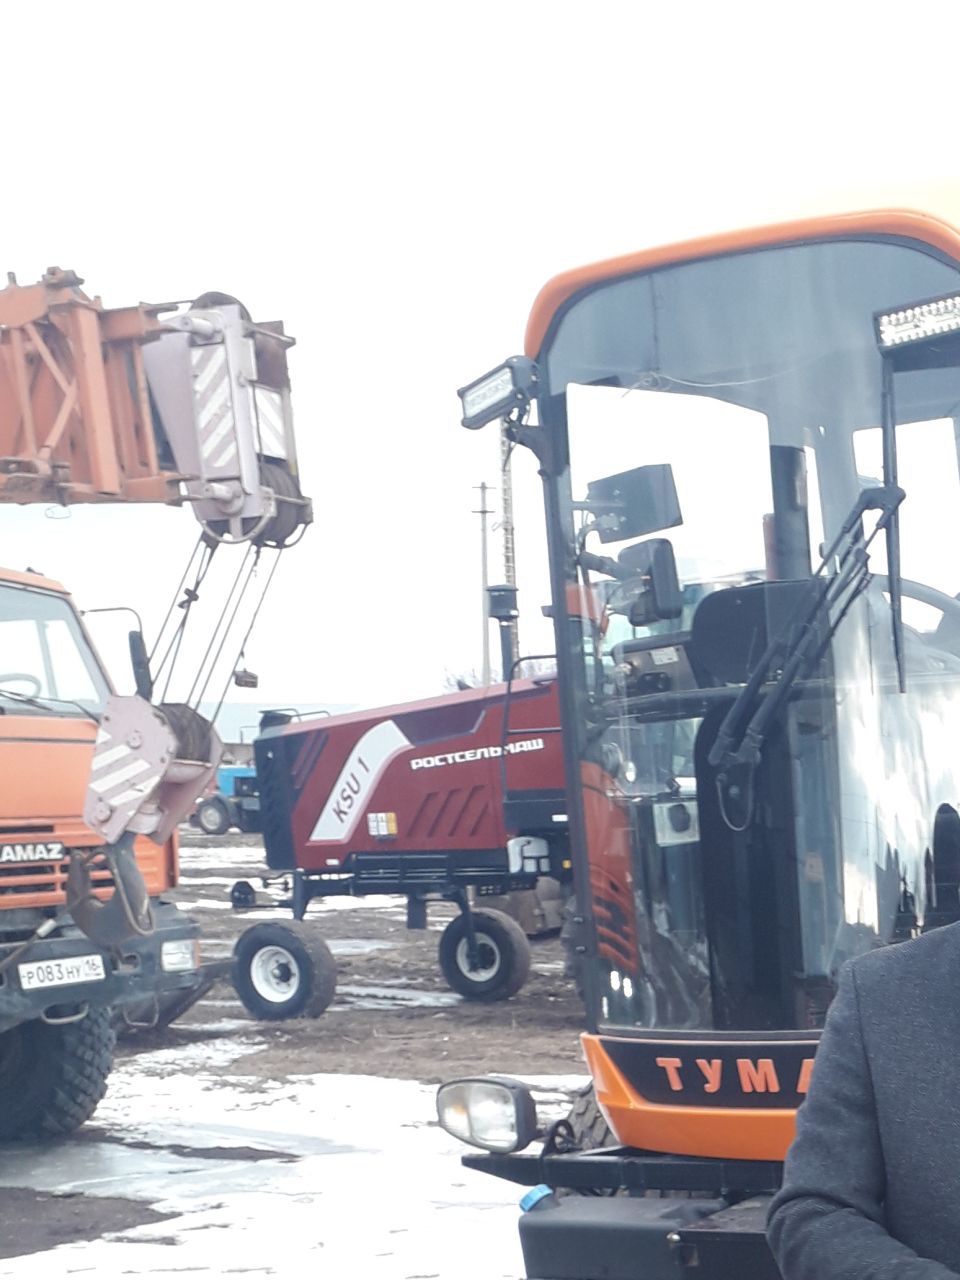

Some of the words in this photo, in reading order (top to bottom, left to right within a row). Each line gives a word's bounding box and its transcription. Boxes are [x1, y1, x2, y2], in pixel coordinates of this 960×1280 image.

[332, 773, 361, 823] KSU
[358, 757, 370, 773] 1
[0, 843, 63, 862] AMAZ
